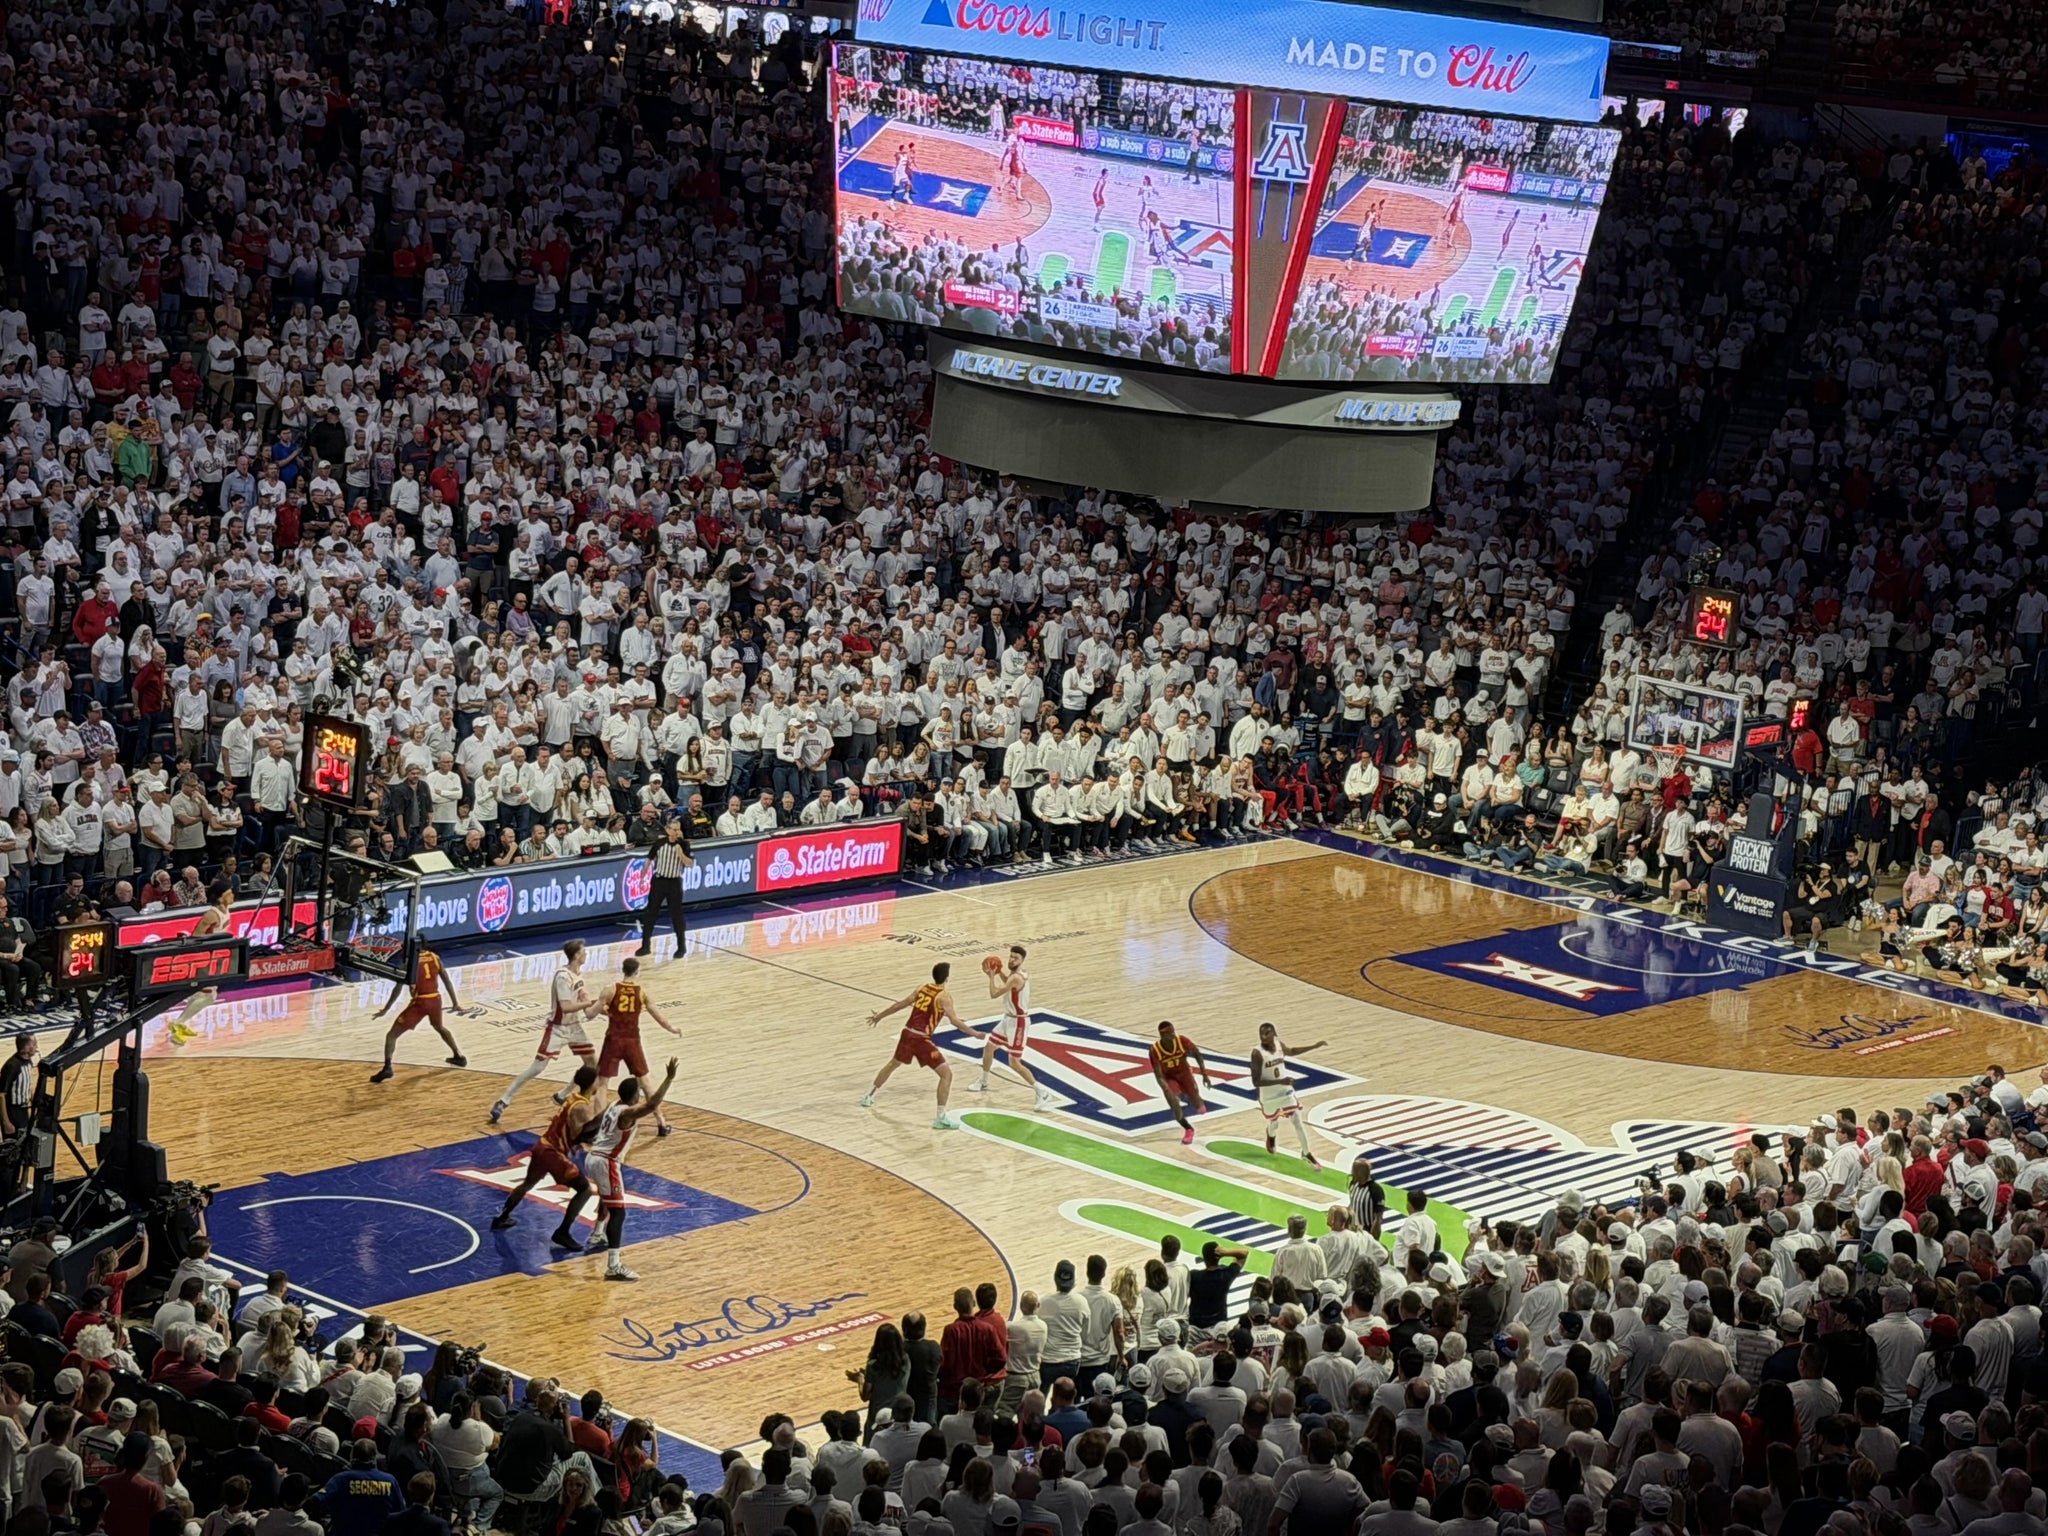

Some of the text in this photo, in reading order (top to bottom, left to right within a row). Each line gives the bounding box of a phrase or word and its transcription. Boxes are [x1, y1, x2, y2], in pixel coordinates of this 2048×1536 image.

[956, 0, 1168, 51] Coors LIGHT
[1286, 37, 1387, 74] MADE
[1398, 49, 1437, 79] TO
[998, 294, 1015, 309] 22
[1044, 300, 1061, 316] 26
[1436, 340, 1449, 353] 26
[1028, 365, 1123, 397] CENTER
[378, 595, 393, 613] 32
[1703, 596, 1732, 614] 2:44
[1695, 612, 1728, 640] 24
[322, 729, 357, 757] 2:44
[315, 753, 349, 795] 24
[705, 854, 751, 888] above
[1729, 854, 1768, 875] PROTEIN
[517, 889, 530, 915] a
[532, 878, 562, 911] sub
[565, 874, 615, 908] above
[1736, 891, 1775, 909] Vantage
[417, 894, 468, 929] above
[1733, 900, 1757, 915] West
[70, 930, 105, 950] 2:44
[68, 953, 94, 977] 24
[150, 949, 231, 984] ESPN
[424, 963, 431, 979] 1
[618, 994, 636, 1013] 21
[914, 993, 932, 1012] 22
[690, 1313, 884, 1371] LUTE & BOBBI OLSON COURT
[350, 1479, 392, 1496] SECURITY
